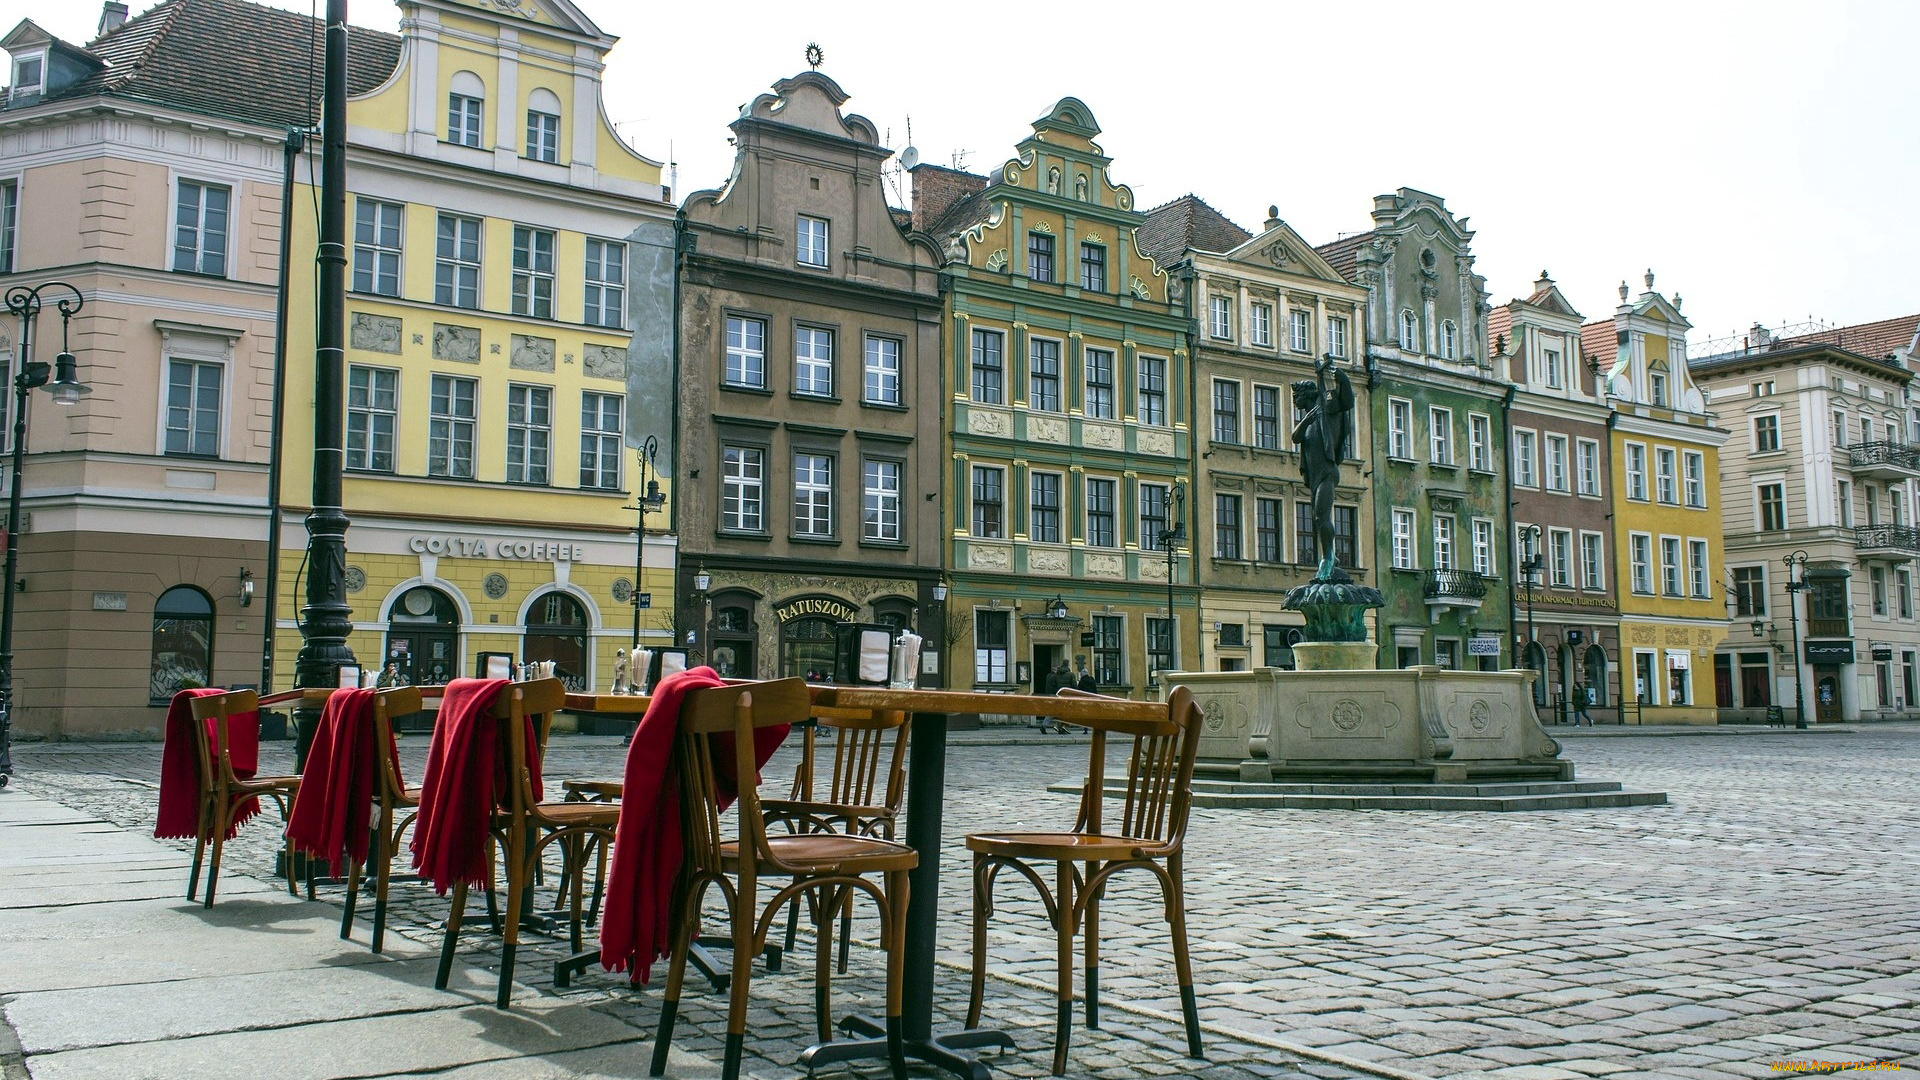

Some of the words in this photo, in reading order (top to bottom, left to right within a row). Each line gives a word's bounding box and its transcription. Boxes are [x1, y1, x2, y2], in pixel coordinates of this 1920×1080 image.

[410, 534, 488, 557] COSTA
[497, 540, 583, 561] COFFEE
[776, 599, 856, 623] RATUSZOVA
